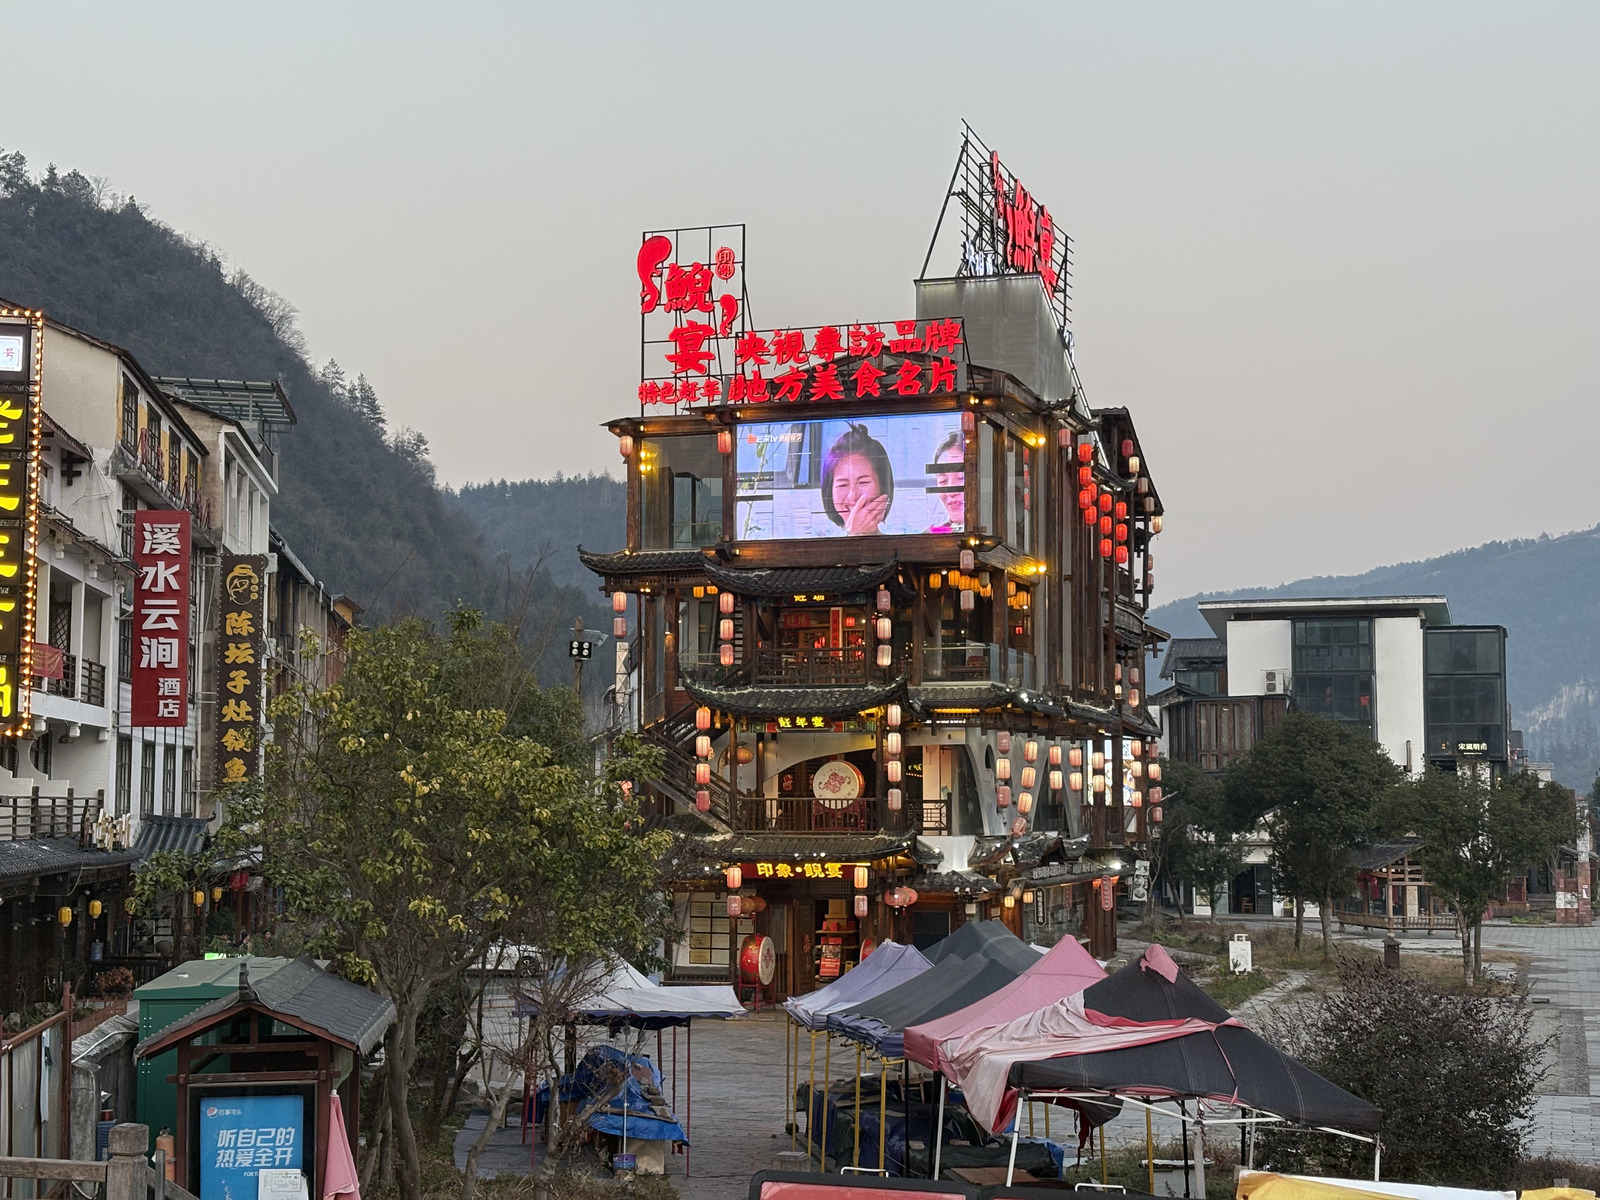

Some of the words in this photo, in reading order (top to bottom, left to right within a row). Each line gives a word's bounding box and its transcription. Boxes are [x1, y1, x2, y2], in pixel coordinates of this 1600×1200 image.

[735, 318, 964, 365] 央視專訪品牌
[746, 356, 959, 402] 地方美食名片
[140, 522, 181, 669] 溪水云涧
[157, 677, 181, 718] 酒店
[215, 1147, 294, 1168] 热爱全开
[217, 1126, 296, 1148] 听自己的
